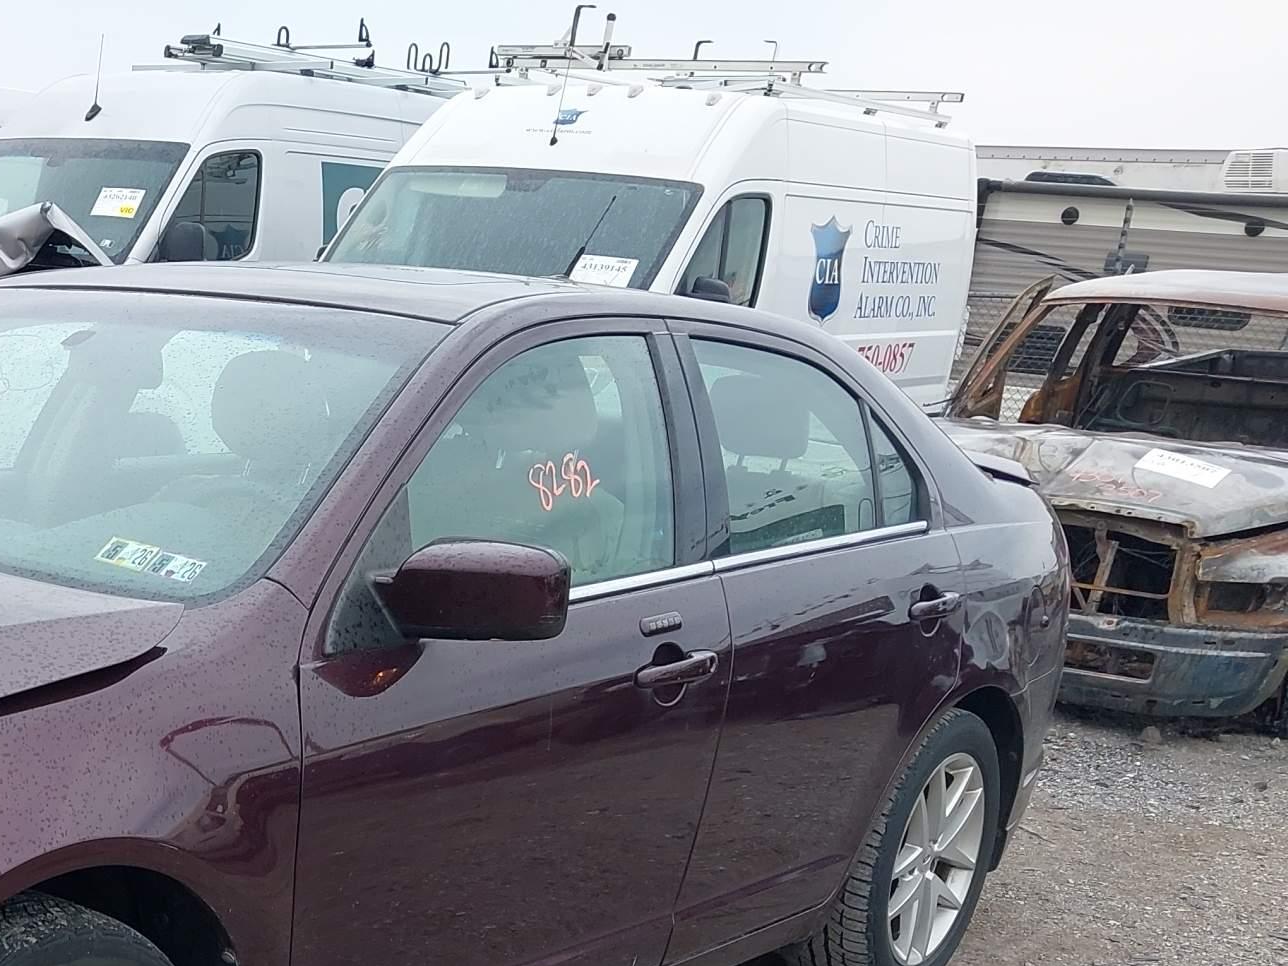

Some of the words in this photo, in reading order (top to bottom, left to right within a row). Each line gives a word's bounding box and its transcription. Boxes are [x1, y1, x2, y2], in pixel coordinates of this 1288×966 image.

[815, 258, 840, 285] CIA
[861, 256, 941, 285] INTERVENTION
[529, 452, 601, 511] 8282
